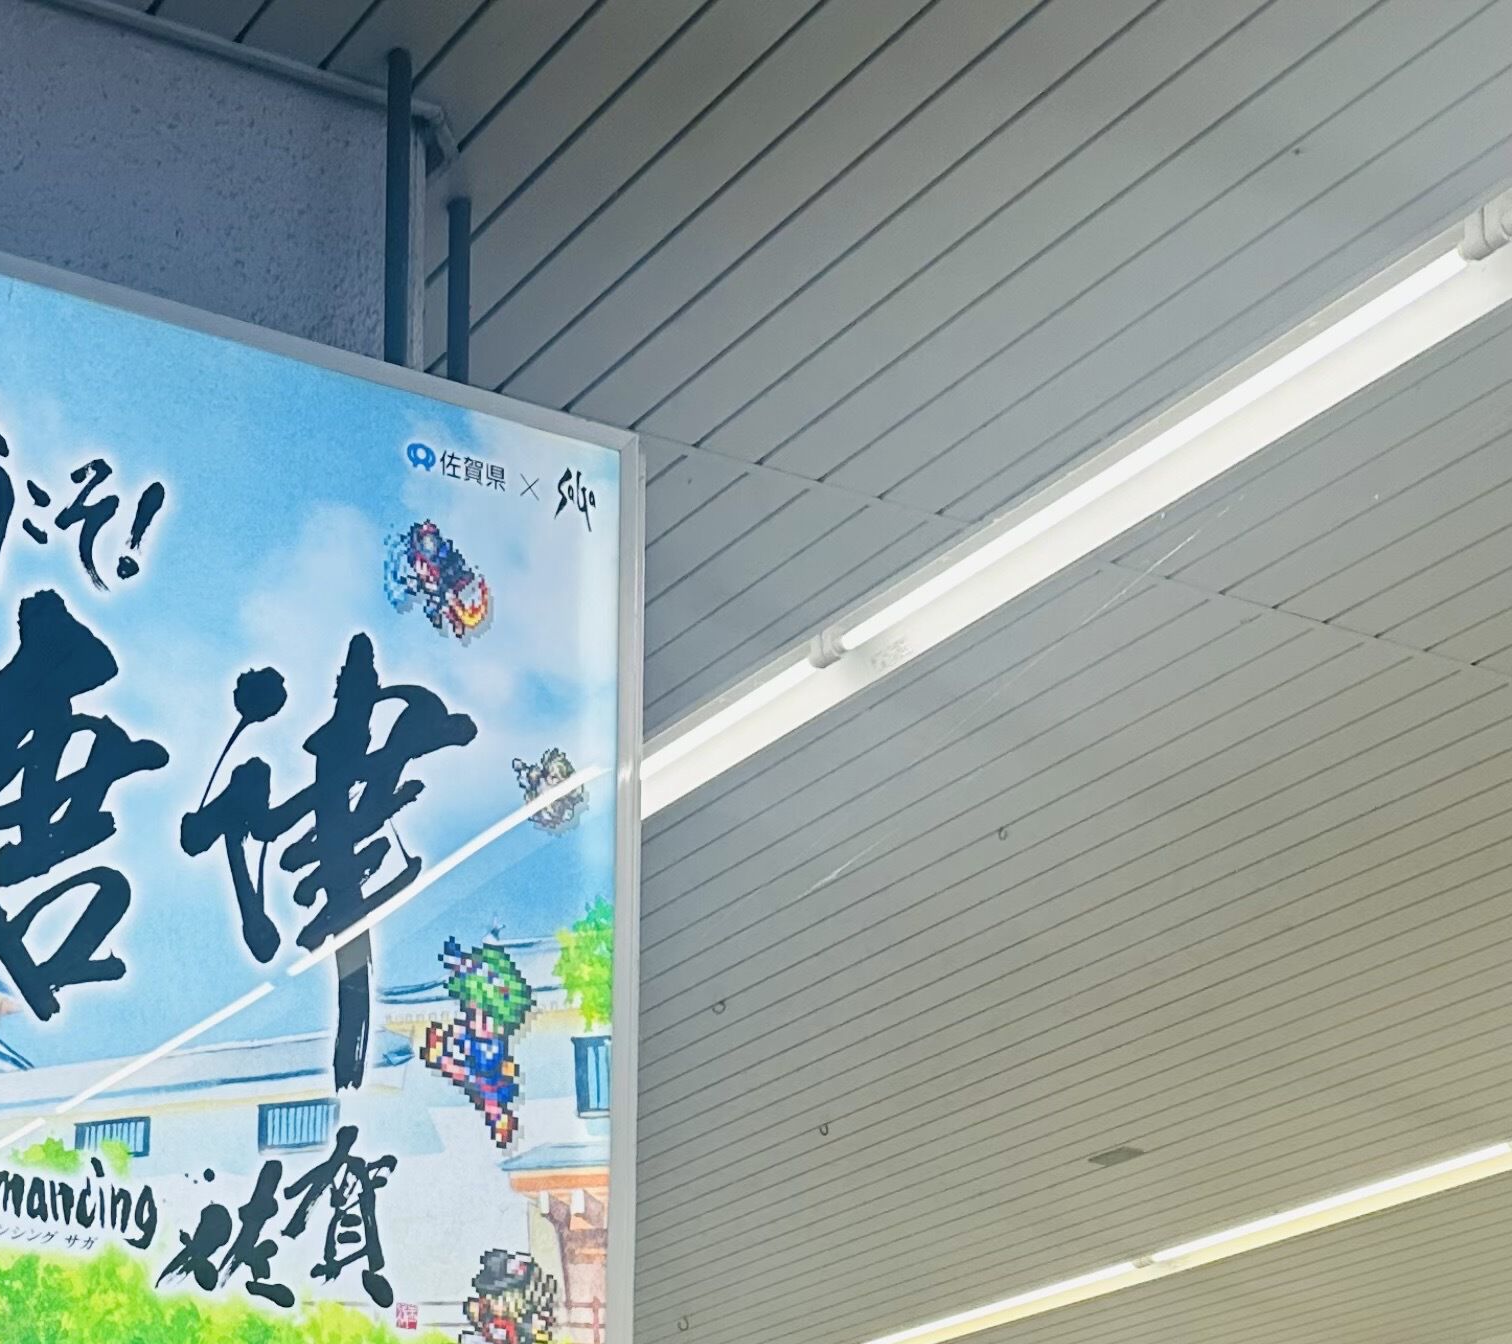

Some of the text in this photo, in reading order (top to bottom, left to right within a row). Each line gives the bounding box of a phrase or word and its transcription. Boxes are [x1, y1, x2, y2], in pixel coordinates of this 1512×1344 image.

[439, 450, 506, 492] 佐賀県
[155, 1125, 398, 1308] 佐賀
